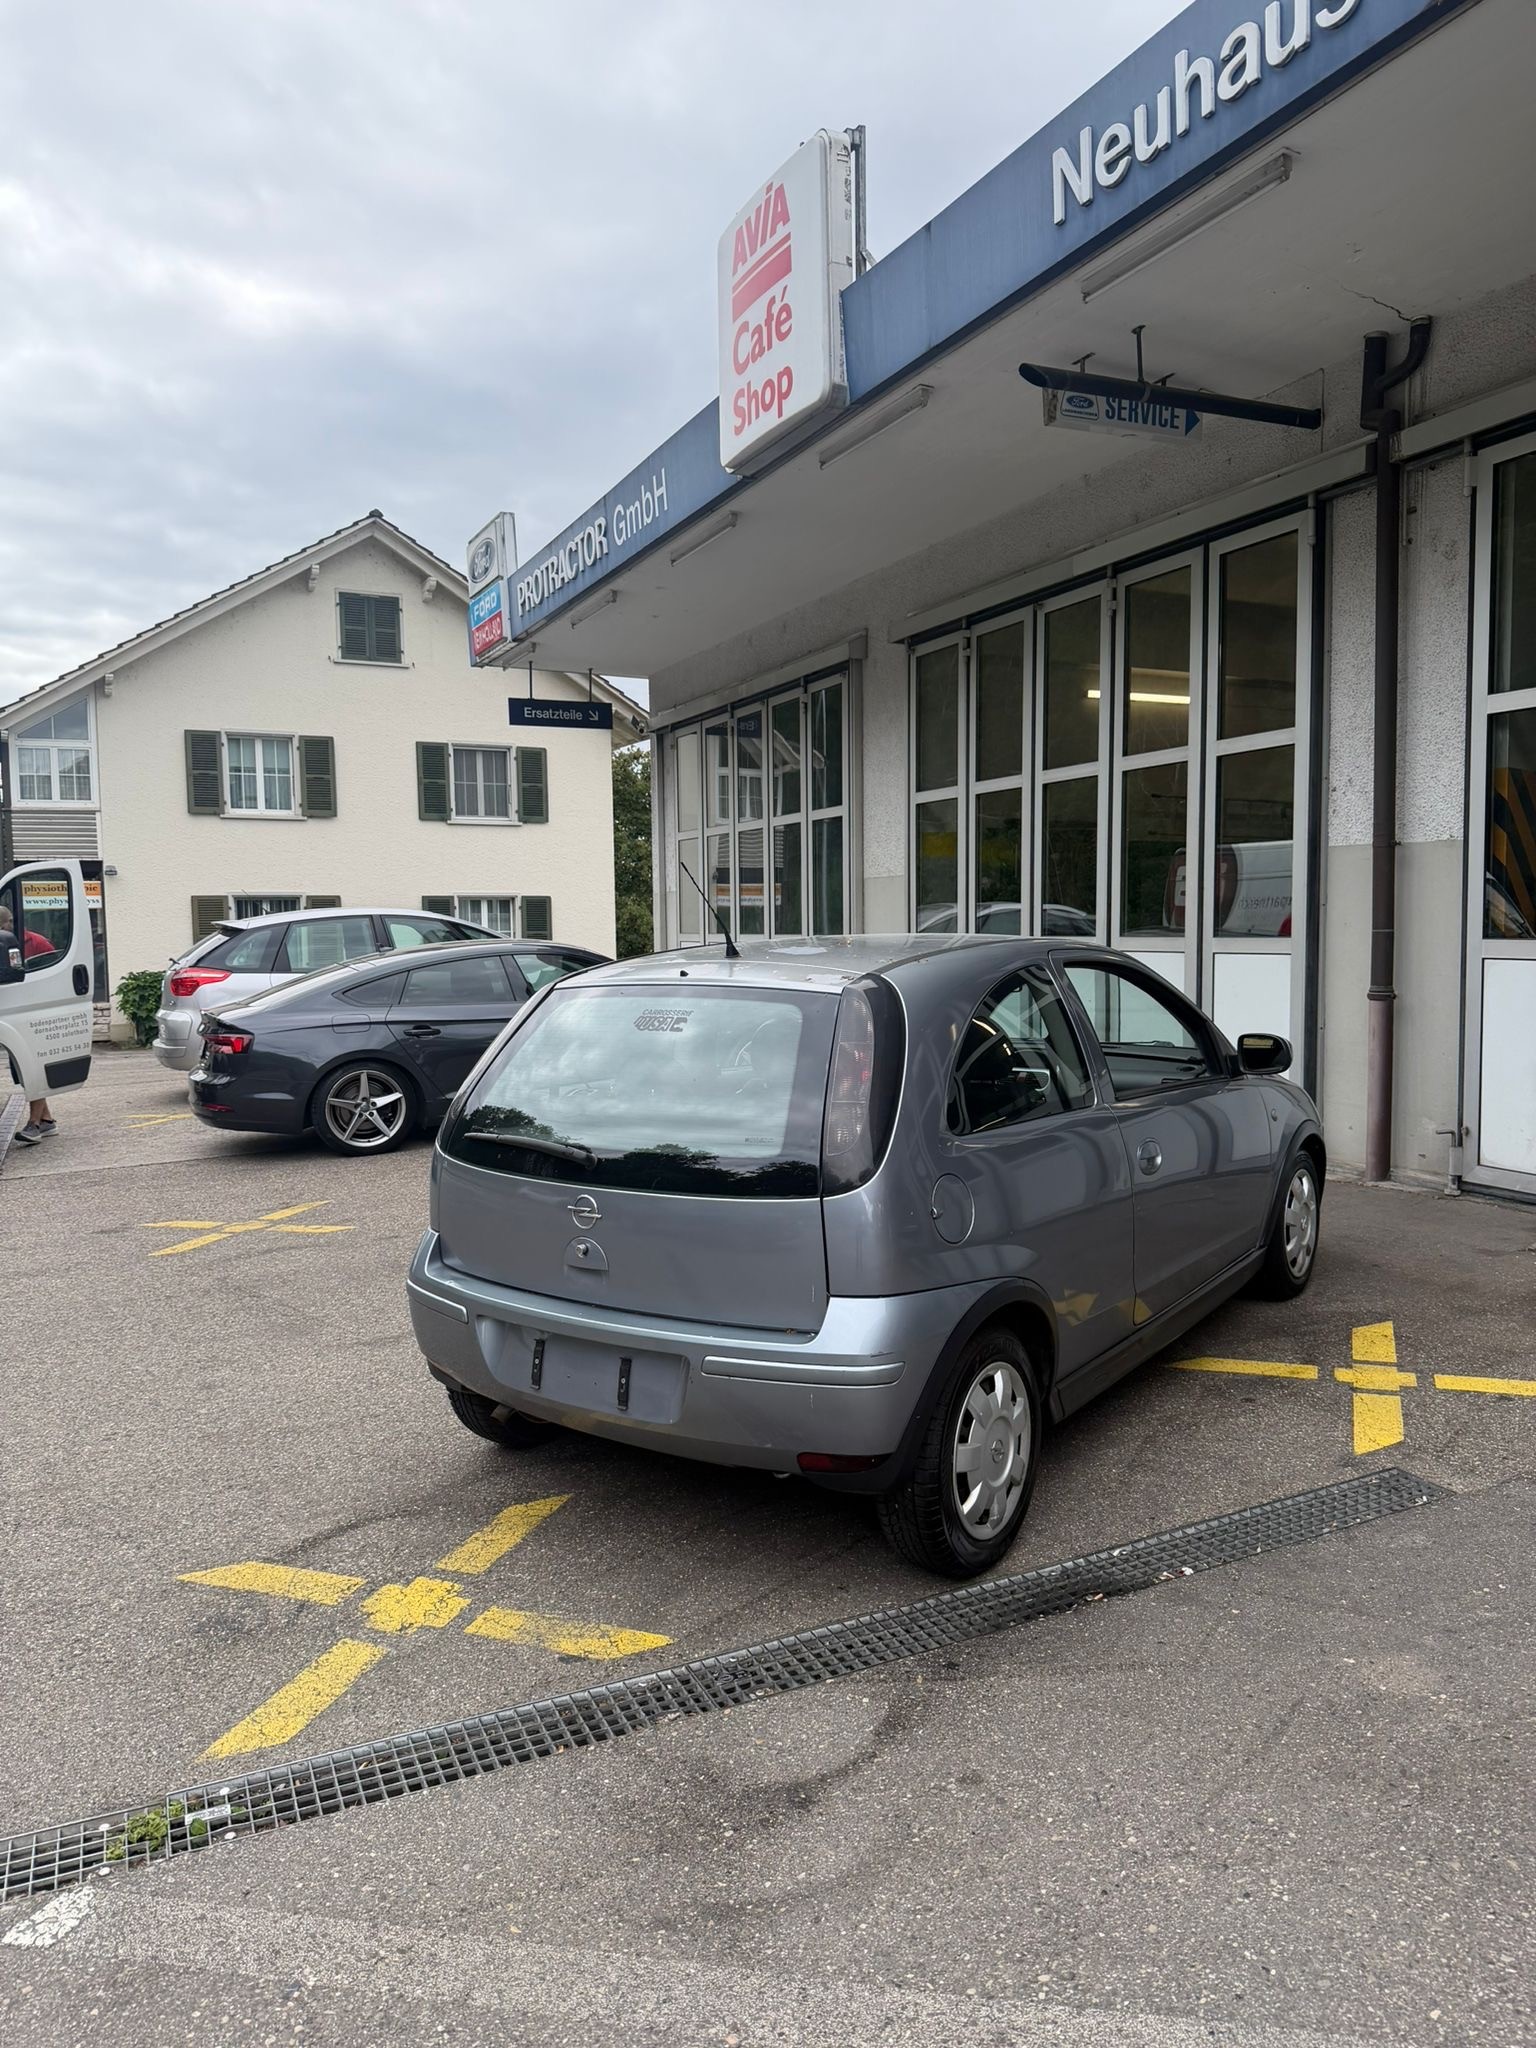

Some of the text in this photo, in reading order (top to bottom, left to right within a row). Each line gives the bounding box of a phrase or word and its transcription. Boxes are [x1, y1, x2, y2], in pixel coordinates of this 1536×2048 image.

[732, 181, 792, 276] AVIA
[732, 284, 793, 376] Café
[732, 365, 793, 437] Shop
[1105, 394, 1180, 429] SERVICE
[517, 468, 669, 617] PROTRACTOR GmbH
[473, 591, 498, 621] FORD
[524, 707, 583, 721] Ersatzteile
